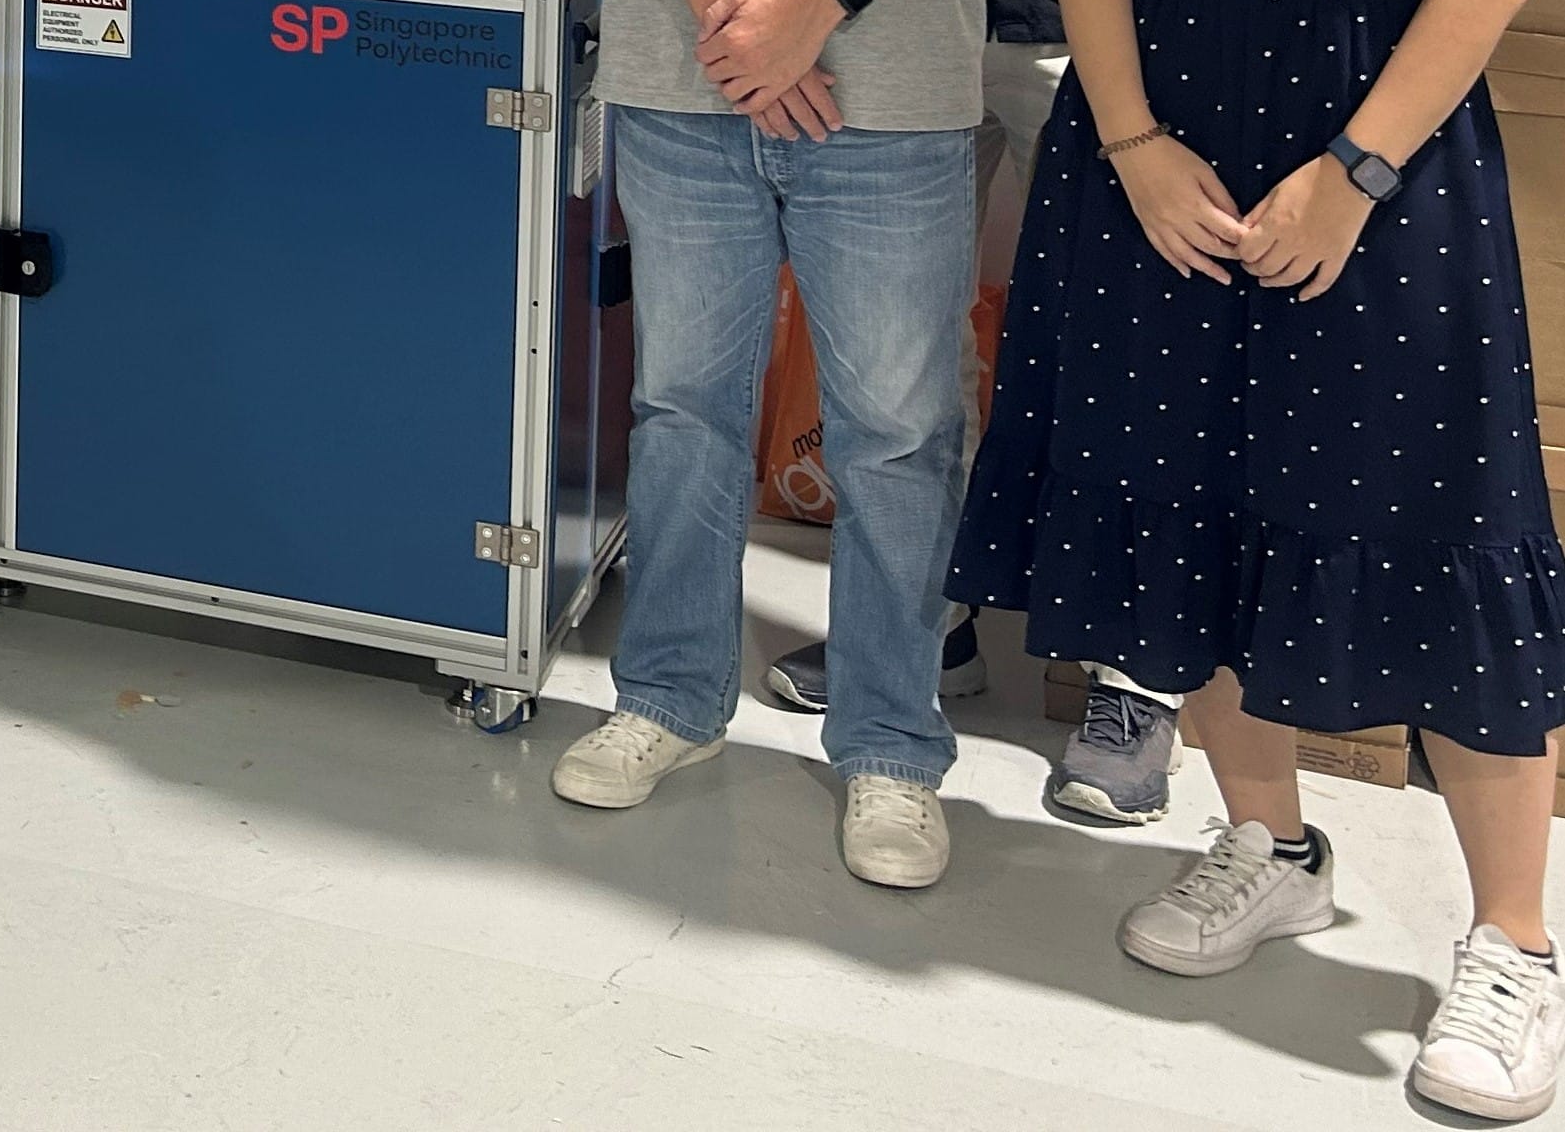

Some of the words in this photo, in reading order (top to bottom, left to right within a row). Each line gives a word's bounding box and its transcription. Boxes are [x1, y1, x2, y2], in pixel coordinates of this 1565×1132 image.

[270, 3, 350, 55] SP
[355, 10, 495, 42] Singapore
[356, 36, 513, 69] Polytechnic
